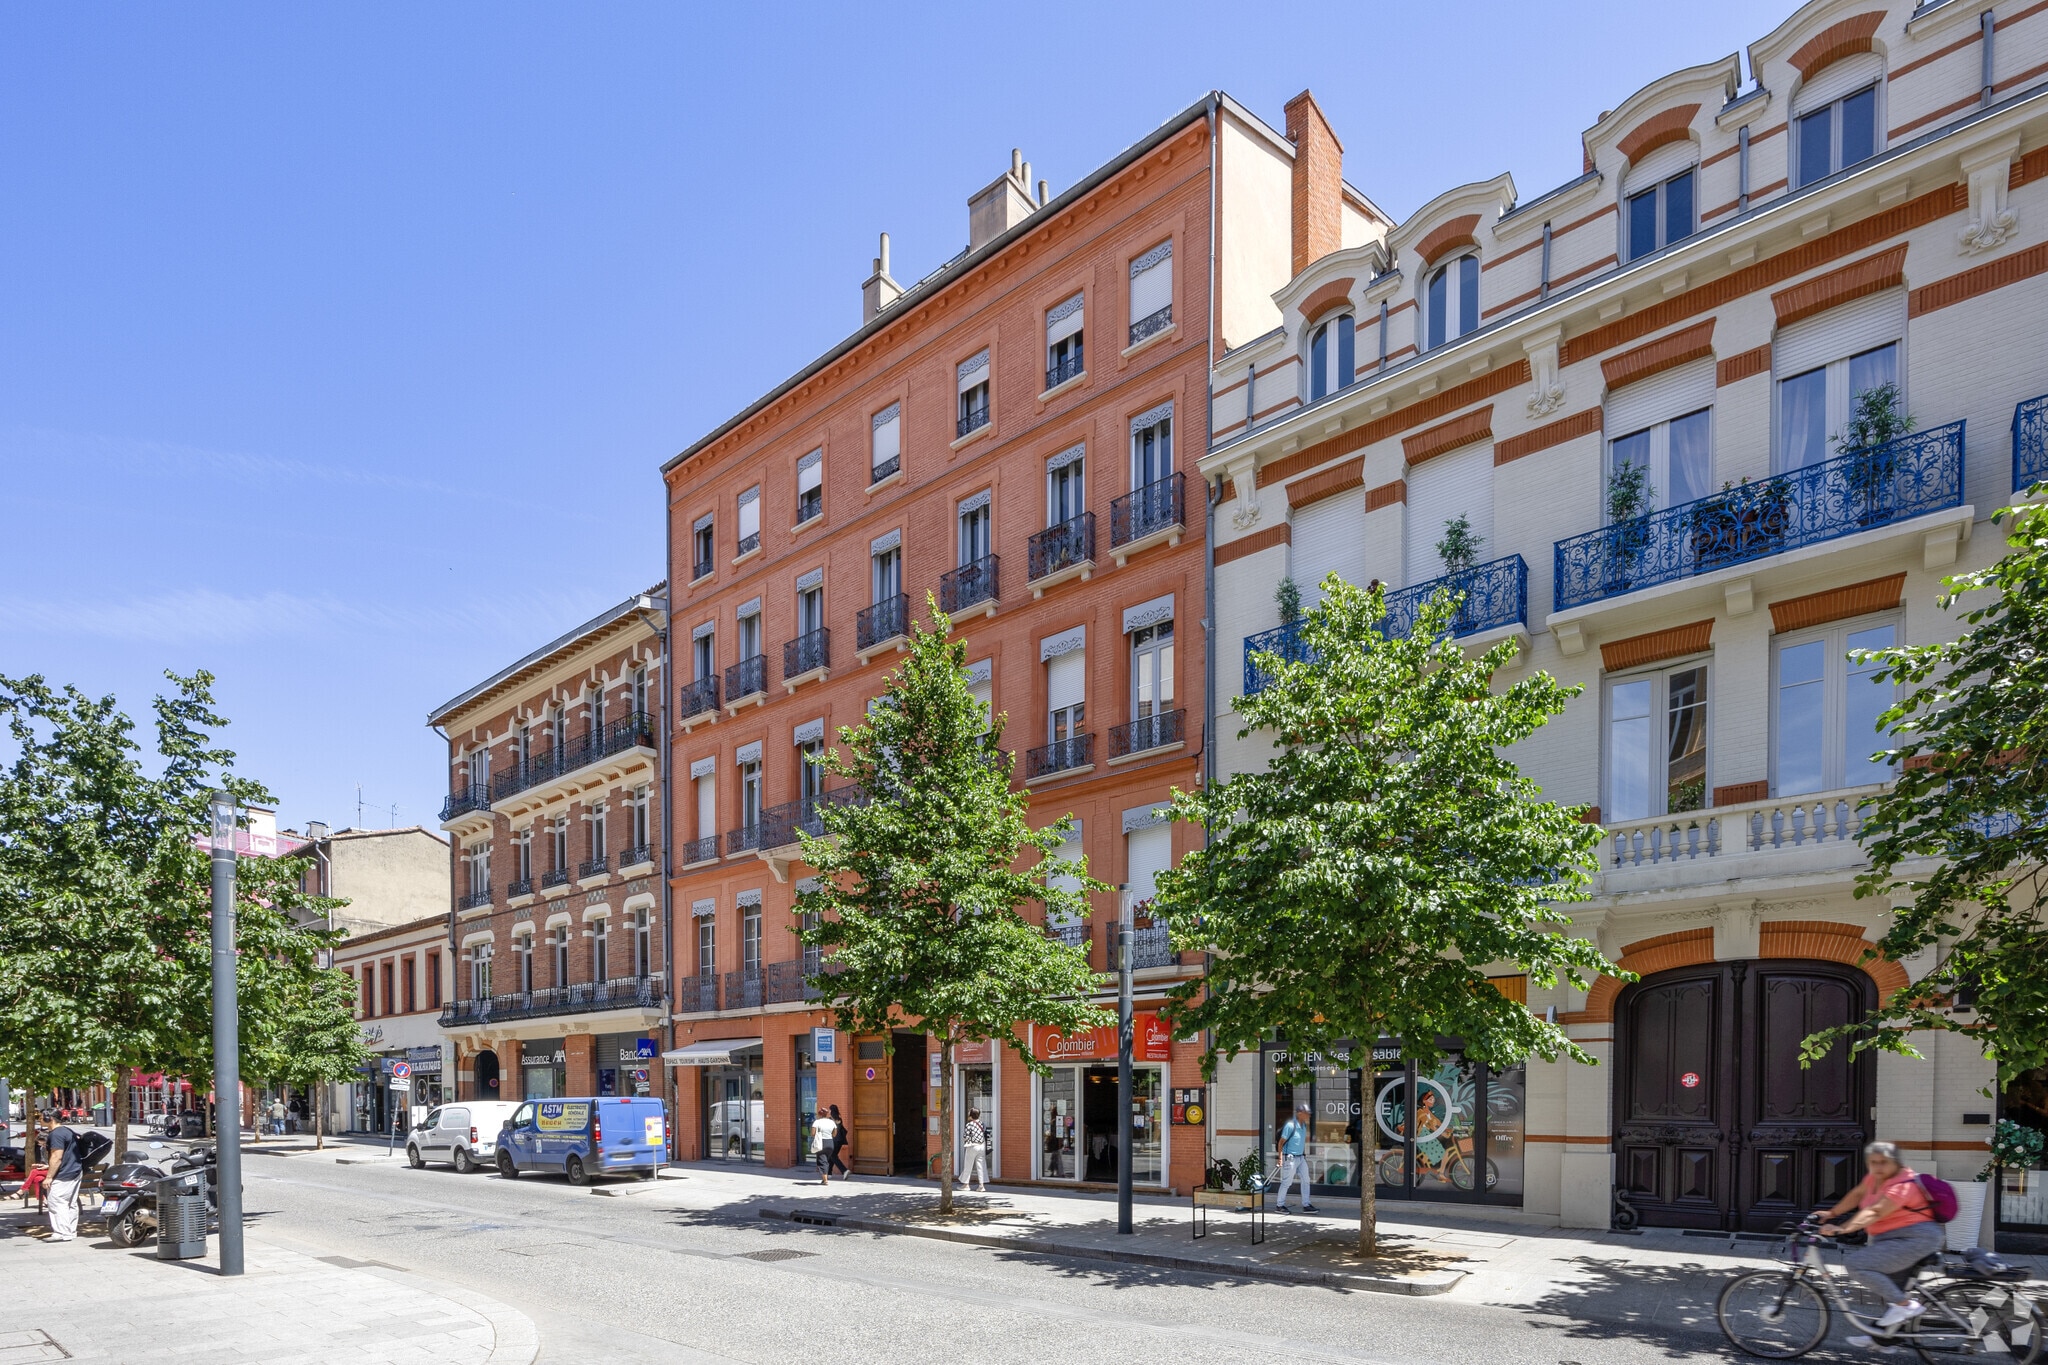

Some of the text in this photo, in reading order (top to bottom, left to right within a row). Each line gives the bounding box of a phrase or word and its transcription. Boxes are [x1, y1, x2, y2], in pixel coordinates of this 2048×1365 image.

[1146, 1028, 1169, 1042] Colombier
[1045, 1033, 1096, 1054] Colombier
[521, 1050, 566, 1065] Assurance AXA
[638, 1047, 653, 1057] AXA
[542, 1104, 563, 1114] ASTM
[1325, 1102, 1392, 1116] ORIGE
[1495, 1134, 1514, 1142] Offre
